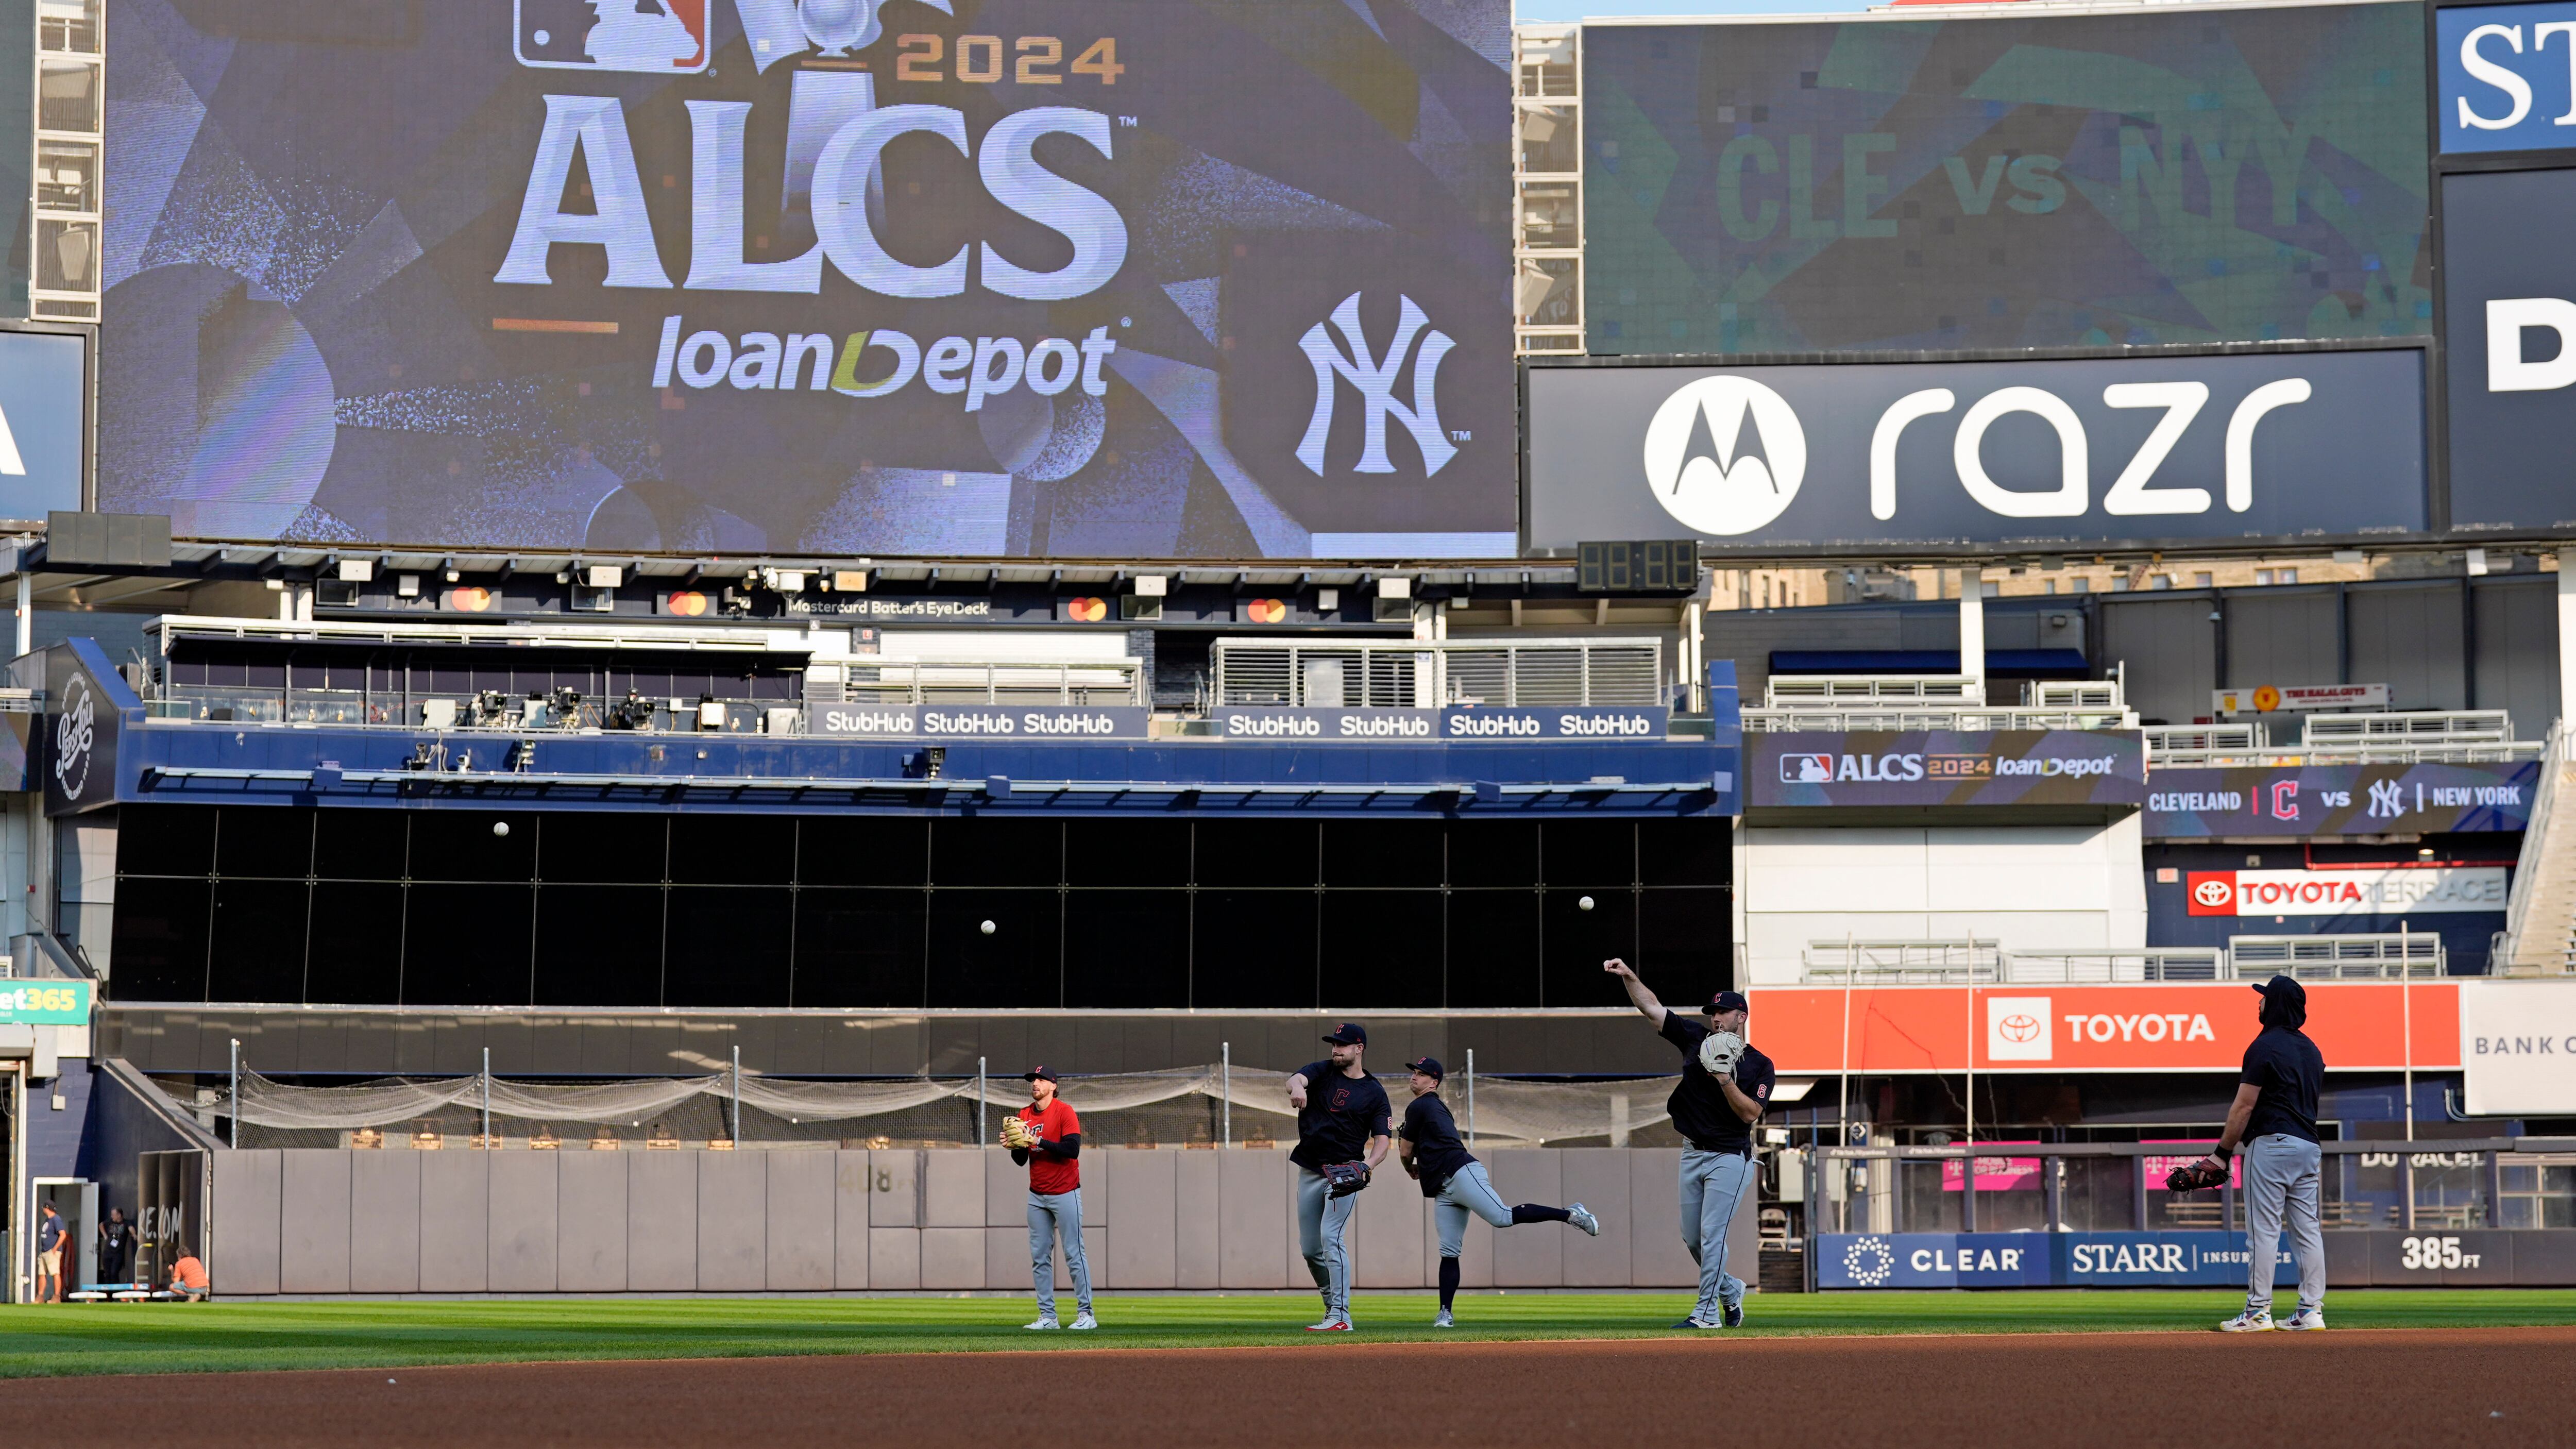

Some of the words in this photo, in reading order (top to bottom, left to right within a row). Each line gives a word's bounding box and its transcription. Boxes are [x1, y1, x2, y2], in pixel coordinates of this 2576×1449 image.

[896, 33, 1125, 85] 2024
[1716, 132, 1899, 242] CLE
[2119, 121, 2317, 231] NYY
[493, 94, 1128, 300] ALCS
[651, 315, 1117, 413] loanDepot
[1870, 377, 2312, 520] razr
[788, 599, 868, 614] Mastercard
[871, 601, 924, 615] Batter's
[926, 601, 952, 617] Eye
[953, 601, 989, 615] Deck
[826, 711, 913, 732] StubHub
[924, 713, 1014, 734] StubHub
[1024, 713, 1114, 734] StubHub
[1229, 715, 1320, 736] StubHub
[1340, 715, 1430, 736] StubHub
[1449, 715, 1540, 736] StubHub
[1560, 714, 1650, 735] StubHub
[1836, 753, 1924, 782] ALCS
[1927, 759, 1991, 774] 2024
[1995, 755, 2114, 779] loanDepot
[2149, 791, 2241, 812] CLEVELAND
[2271, 779, 2299, 821] C
[2433, 788, 2471, 807] NEW
[2474, 785, 2521, 805] YORK
[2241, 881, 2362, 904] TOYOTA
[2362, 879, 2502, 903] TERRACE
[2065, 1013, 2215, 1042] TOYOTA
[2475, 1036, 2553, 1054] BANK
[1332, 1088, 1350, 1106] C
[1757, 1084, 1767, 1099] 6
[1910, 1249, 2020, 1272] CLEAR
[2073, 1243, 2189, 1273] STARR
[2203, 1251, 2292, 1263] INSURCE
[2402, 1237, 2462, 1269] 385
[2463, 1254, 2481, 1268] FT
